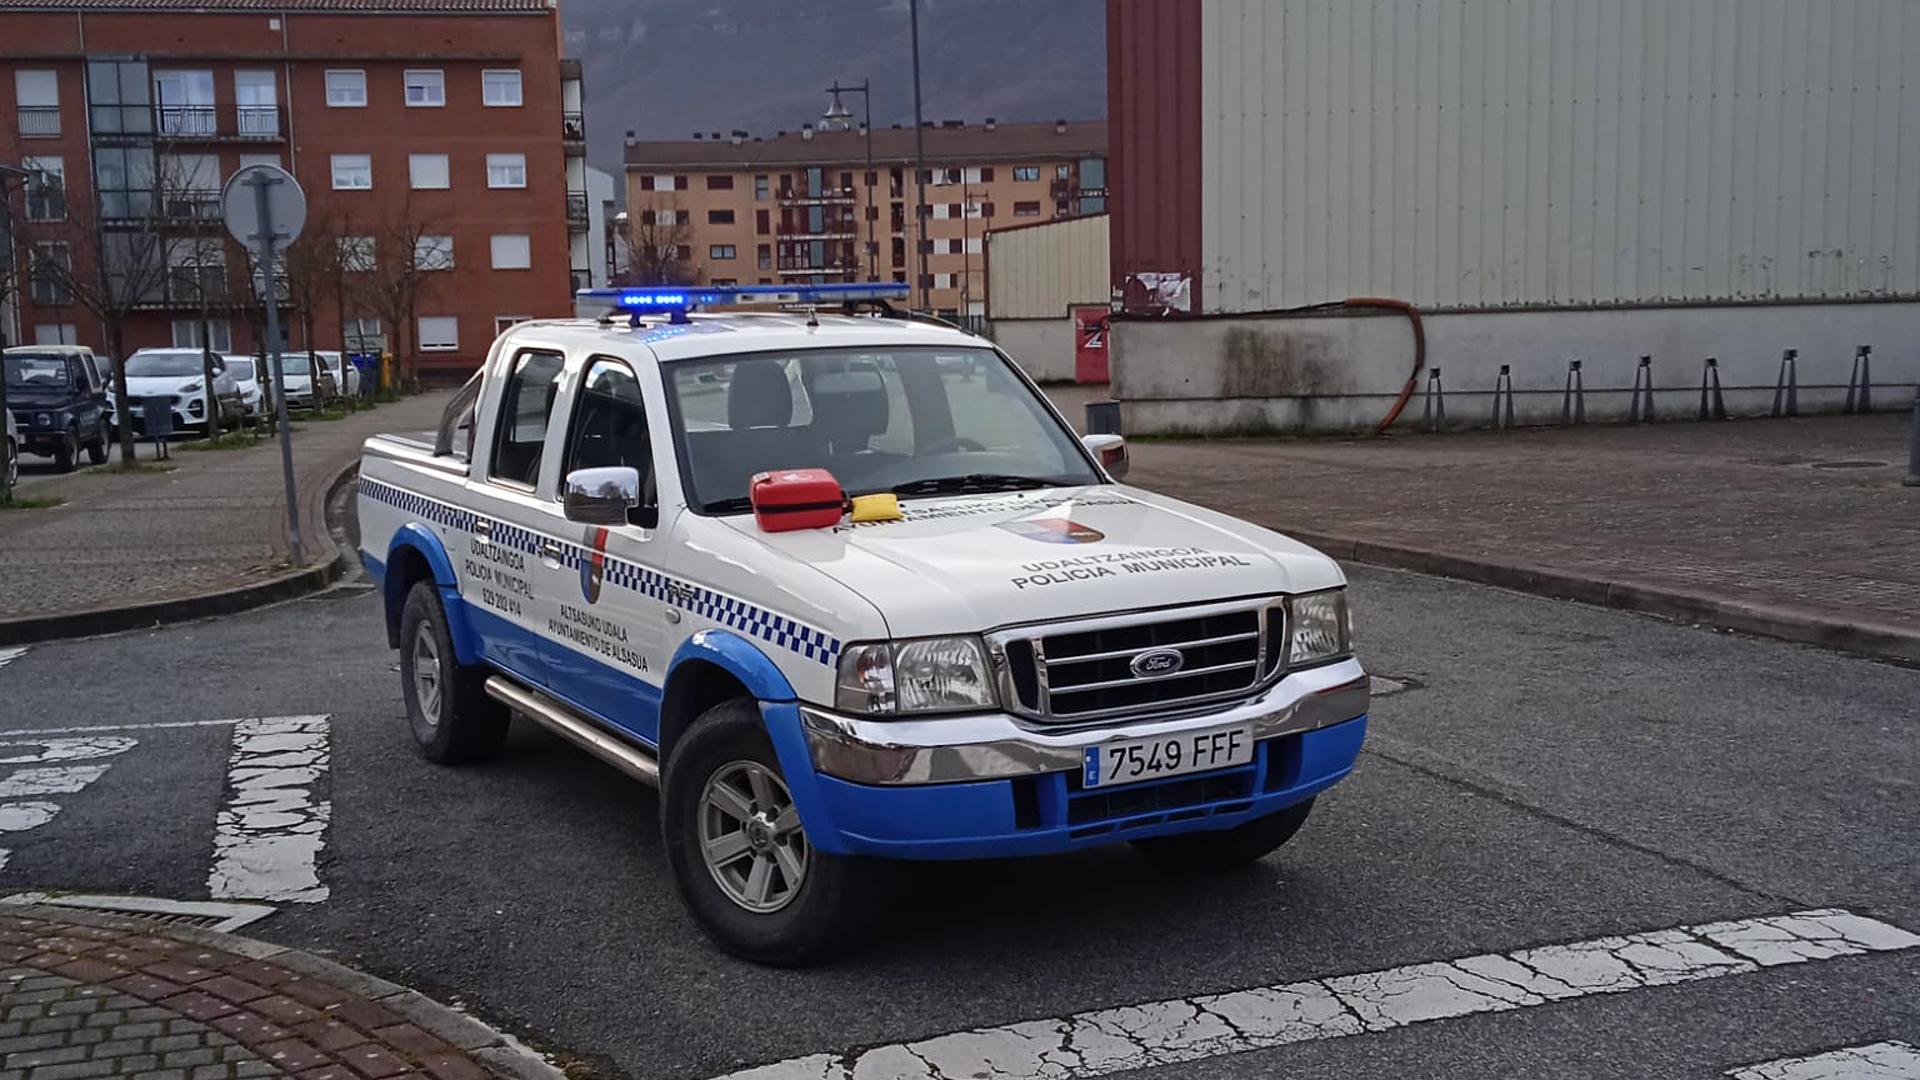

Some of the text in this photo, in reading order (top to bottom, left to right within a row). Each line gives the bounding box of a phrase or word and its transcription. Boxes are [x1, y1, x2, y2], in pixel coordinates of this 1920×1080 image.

[1011, 555, 1251, 589] POLICIA MUNICIPAL
[1022, 547, 1210, 572] UDALTZAINGOA
[494, 569, 535, 600] MUNICIPAL
[548, 618, 649, 673] AYUNTAMIENTO DE ALSASUA
[602, 621, 629, 643] UDALA
[1146, 656, 1173, 671] Ford
[1109, 729, 1244, 780] 7549 FFF
